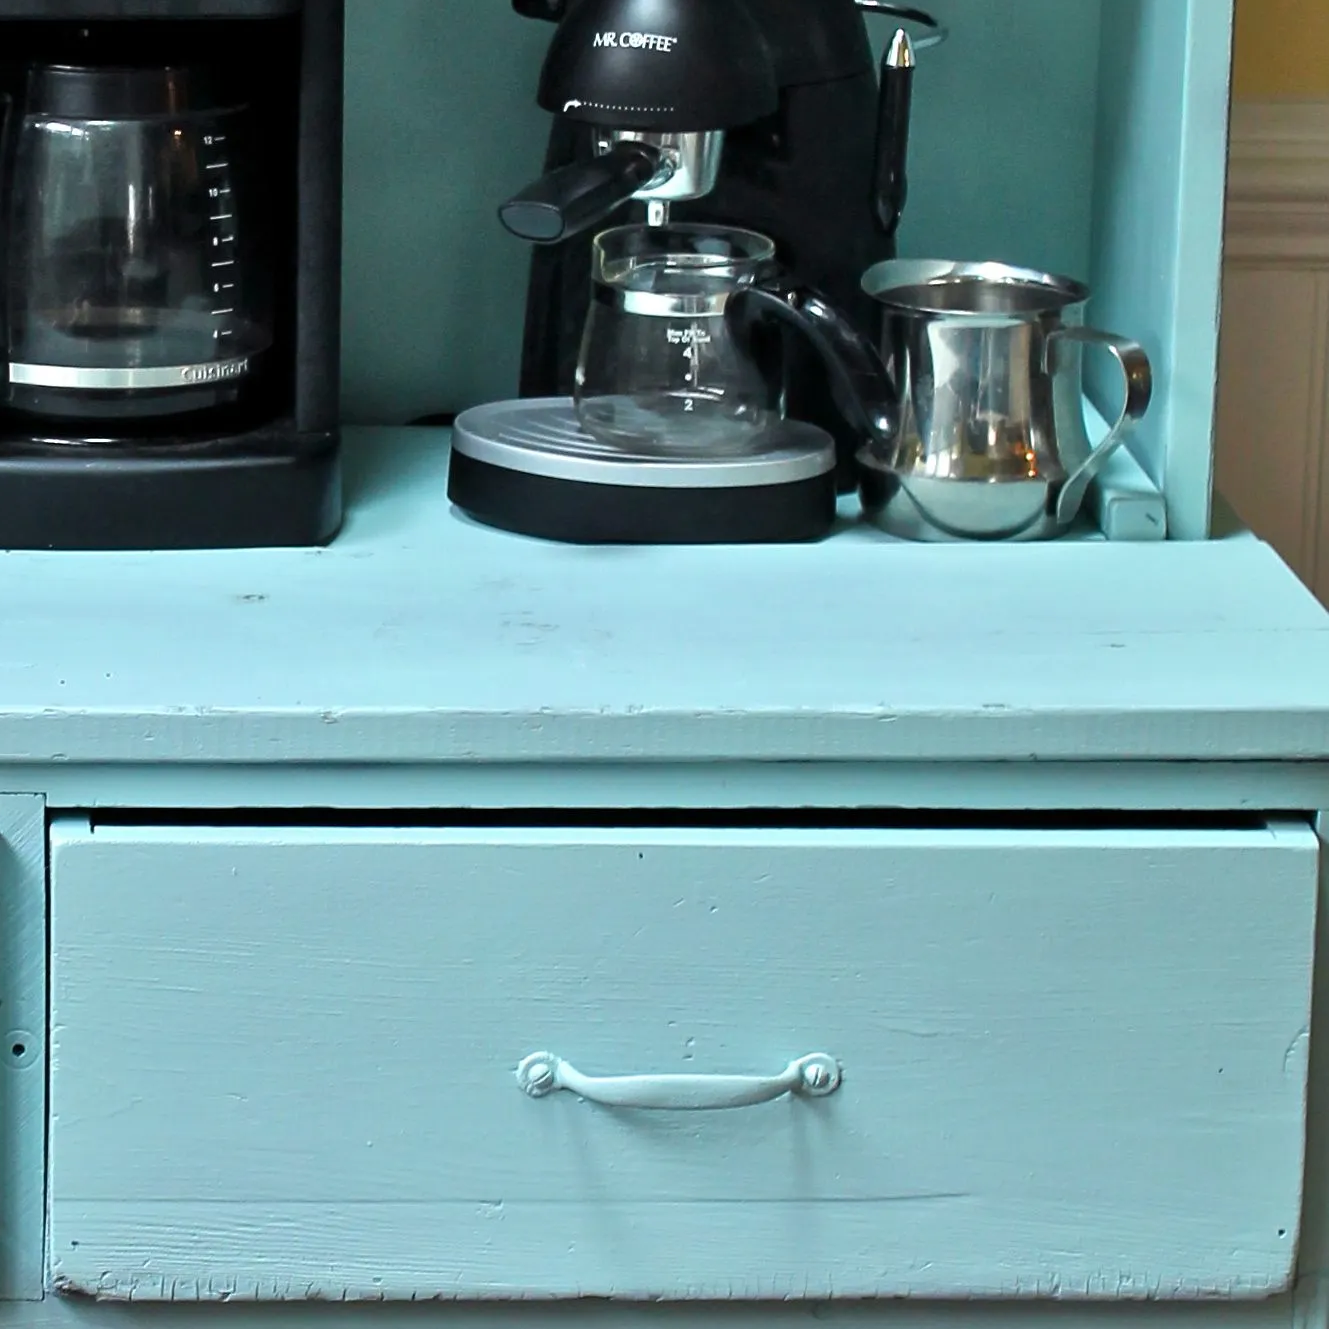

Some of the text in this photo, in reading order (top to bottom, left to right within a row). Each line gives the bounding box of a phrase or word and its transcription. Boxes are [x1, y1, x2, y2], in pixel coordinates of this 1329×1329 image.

[593, 32, 672, 52] MR. COFFEE
[203, 136, 213, 145] 12
[209, 188, 218, 197] 10
[682, 346, 692, 359] 4
[684, 399, 693, 411] 2
